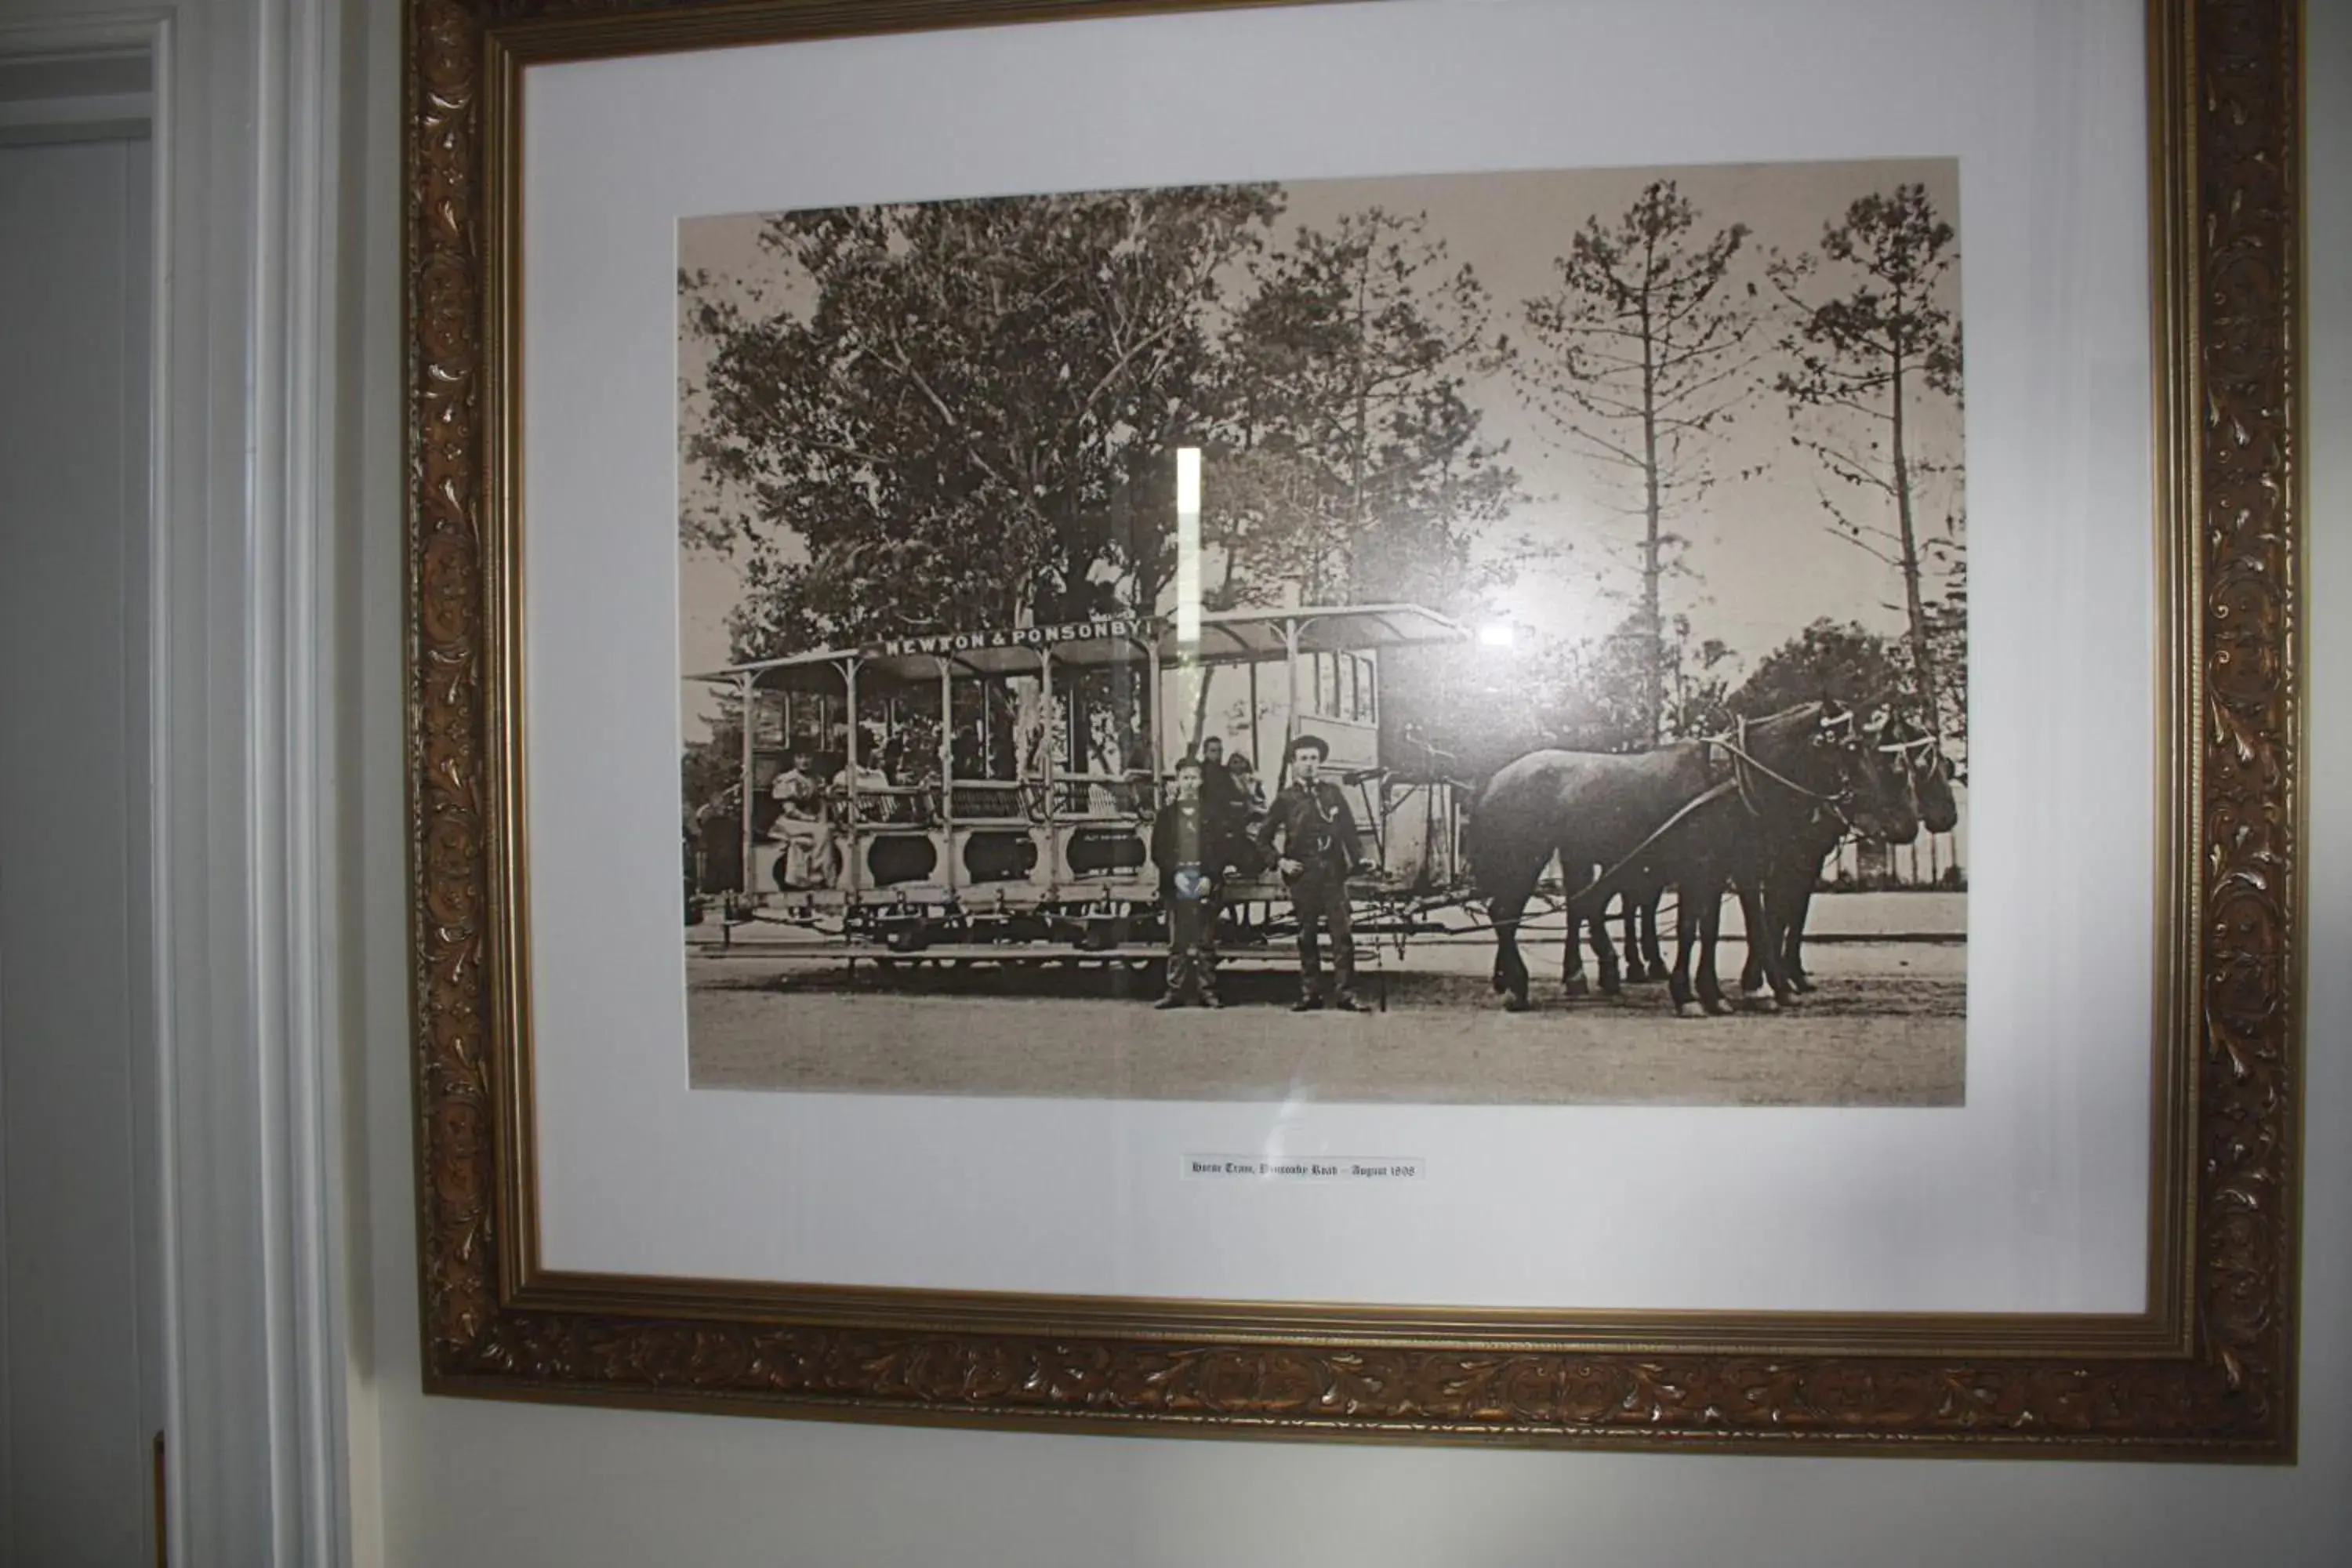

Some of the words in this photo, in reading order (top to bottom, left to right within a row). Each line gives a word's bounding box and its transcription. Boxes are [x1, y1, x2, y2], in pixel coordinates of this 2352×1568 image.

[885, 632, 984, 656] NEWTON
[992, 631, 1006, 646] &
[1012, 619, 1142, 645] PONSONBY
[1192, 1161, 1221, 1173] Horse
[1311, 1164, 1338, 1175] Road
[1352, 1164, 1387, 1178] August
